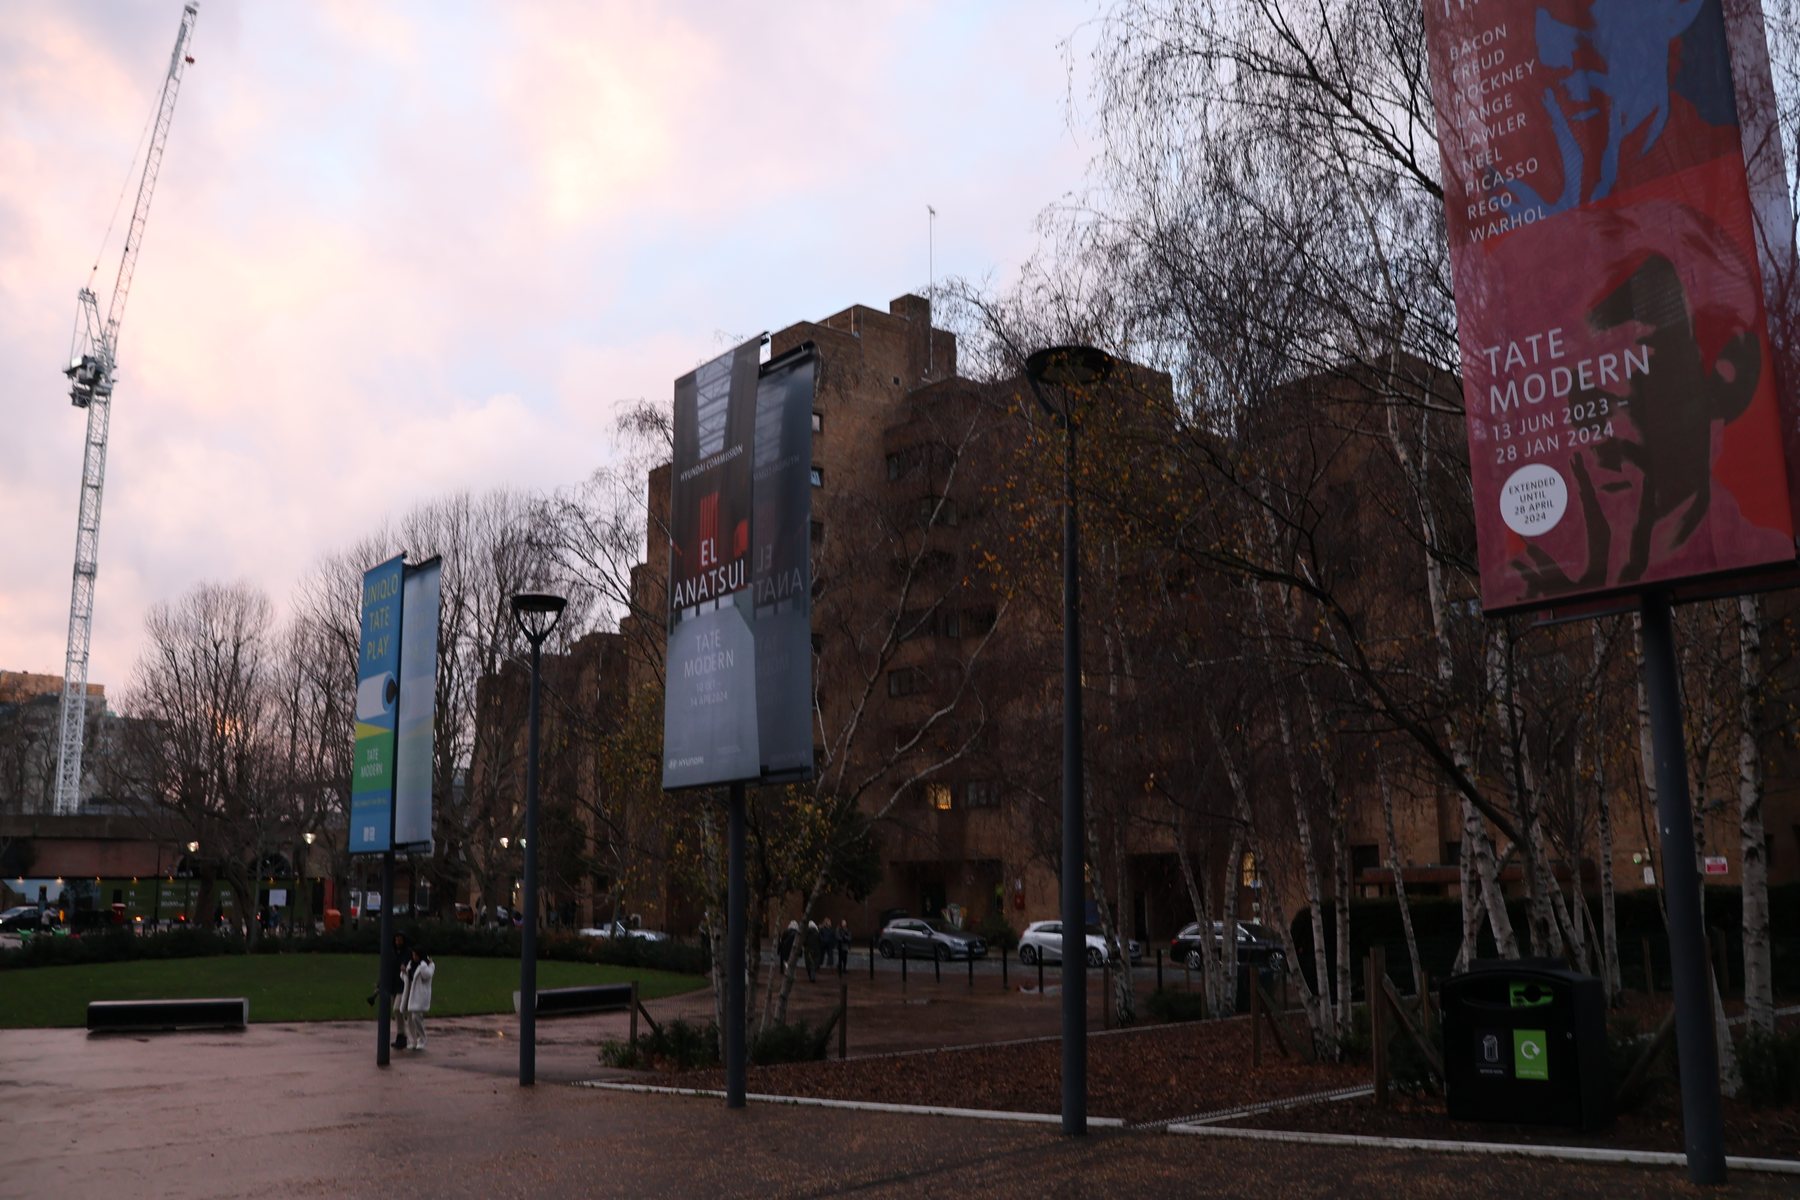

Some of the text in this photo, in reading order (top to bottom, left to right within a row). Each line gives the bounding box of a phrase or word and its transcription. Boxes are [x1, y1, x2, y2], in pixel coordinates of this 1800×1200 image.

[1450, 24, 1507, 61] BACON
[1453, 49, 1505, 83] FREUD
[1455, 58, 1535, 109] HOCKNEY
[1457, 93, 1513, 128] LANGE
[1460, 112, 1527, 150] LAWLER
[1463, 147, 1503, 175] NEEL
[1465, 157, 1538, 198] PICASSO
[1467, 192, 1512, 220] REGO
[1470, 205, 1546, 243] WARHOL
[1484, 327, 1565, 377] TATE
[1490, 344, 1650, 415] MODERN
[1493, 423, 1511, 442] 13
[1519, 411, 1554, 436] JUN
[1562, 397, 1609, 424] 2023
[1496, 421, 1614, 464] 28 JAN 2024
[1508, 477, 1556, 495] EXTENDED
[1519, 490, 1546, 503] UNTIL
[1529, 499, 1554, 512] APRIL
[701, 537, 718, 567] EL
[364, 573, 399, 608] UNIQLO
[673, 558, 745, 609] ANATSUI
[369, 606, 390, 633] TATE
[366, 635, 389, 661] PLAY
[696, 629, 721, 652] TATE
[684, 649, 734, 679] MODERN
